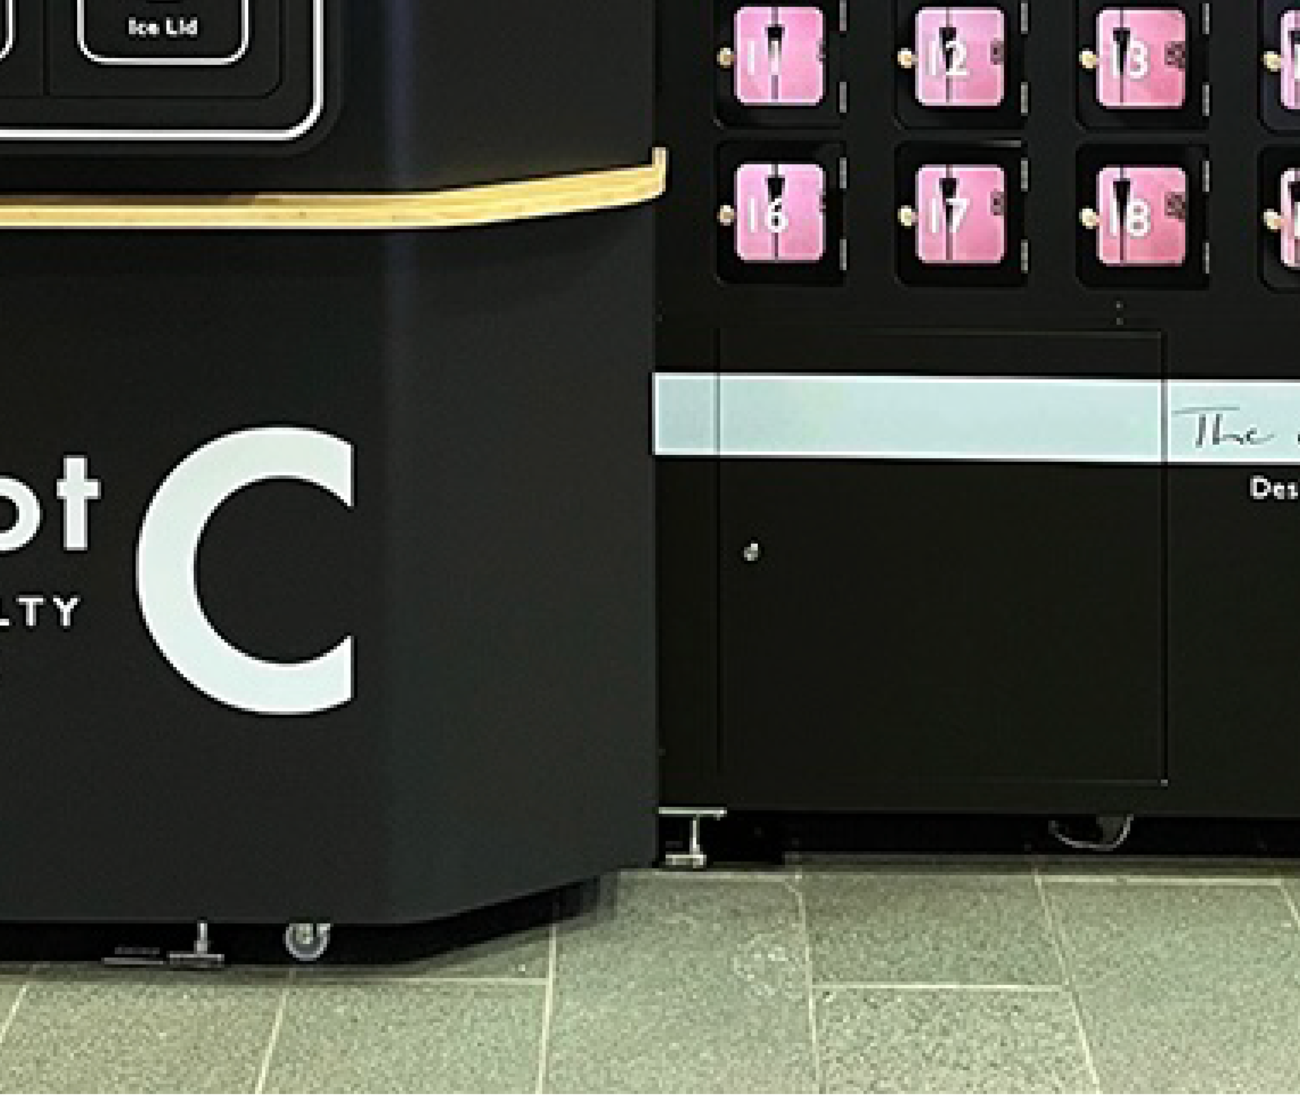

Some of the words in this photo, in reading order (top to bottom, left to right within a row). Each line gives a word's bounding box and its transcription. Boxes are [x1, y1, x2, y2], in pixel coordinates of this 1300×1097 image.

[128, 17, 161, 36] Ice
[166, 16, 198, 36] Lid
[748, 40, 781, 76] 11
[928, 40, 968, 77] 12
[1111, 41, 1149, 80] 13
[750, 197, 788, 234] 16
[931, 198, 969, 234] 17
[1111, 199, 1149, 237] 18
[1172, 405, 1276, 448] The
[135, 426, 355, 716] C
